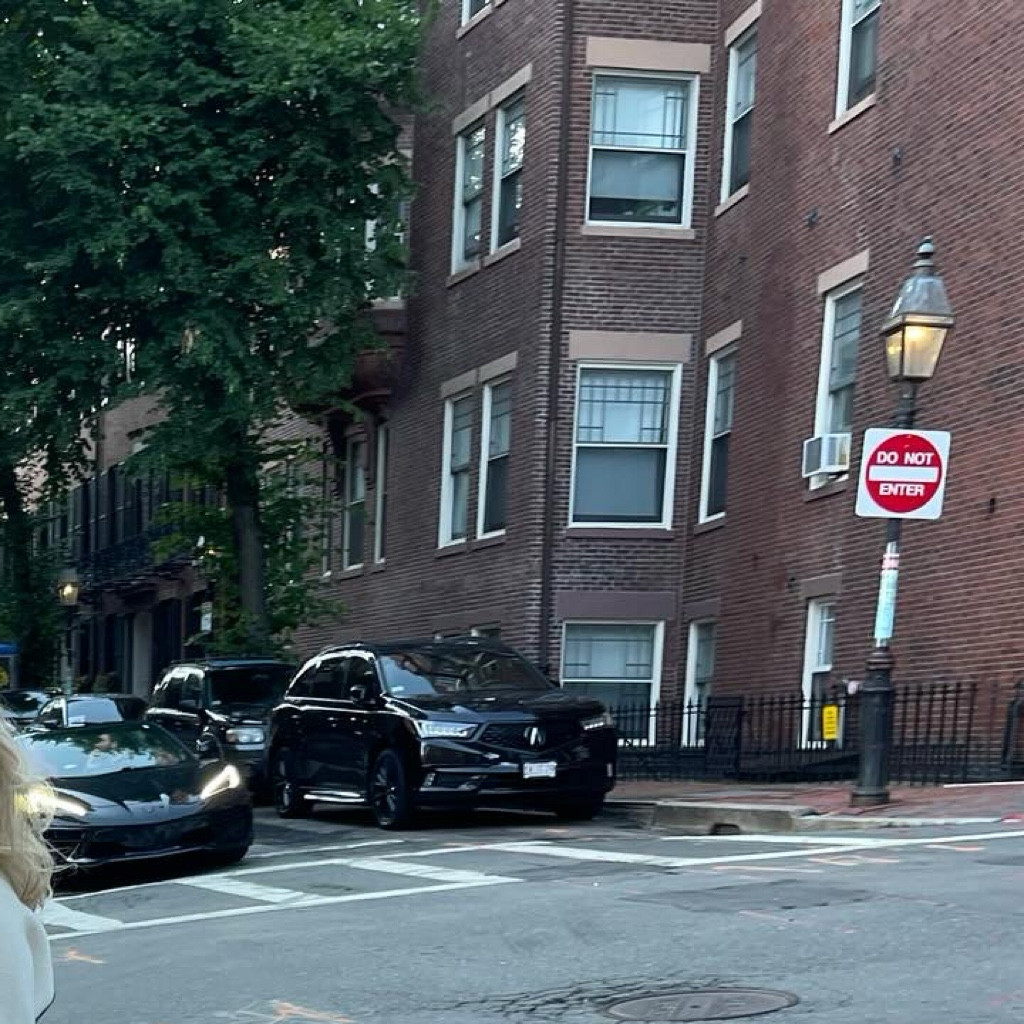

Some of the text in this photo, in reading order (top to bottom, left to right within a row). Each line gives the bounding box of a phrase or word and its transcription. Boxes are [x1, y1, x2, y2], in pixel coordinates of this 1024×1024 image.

[877, 451, 934, 465] DO NOT
[879, 483, 925, 496] ENTER
